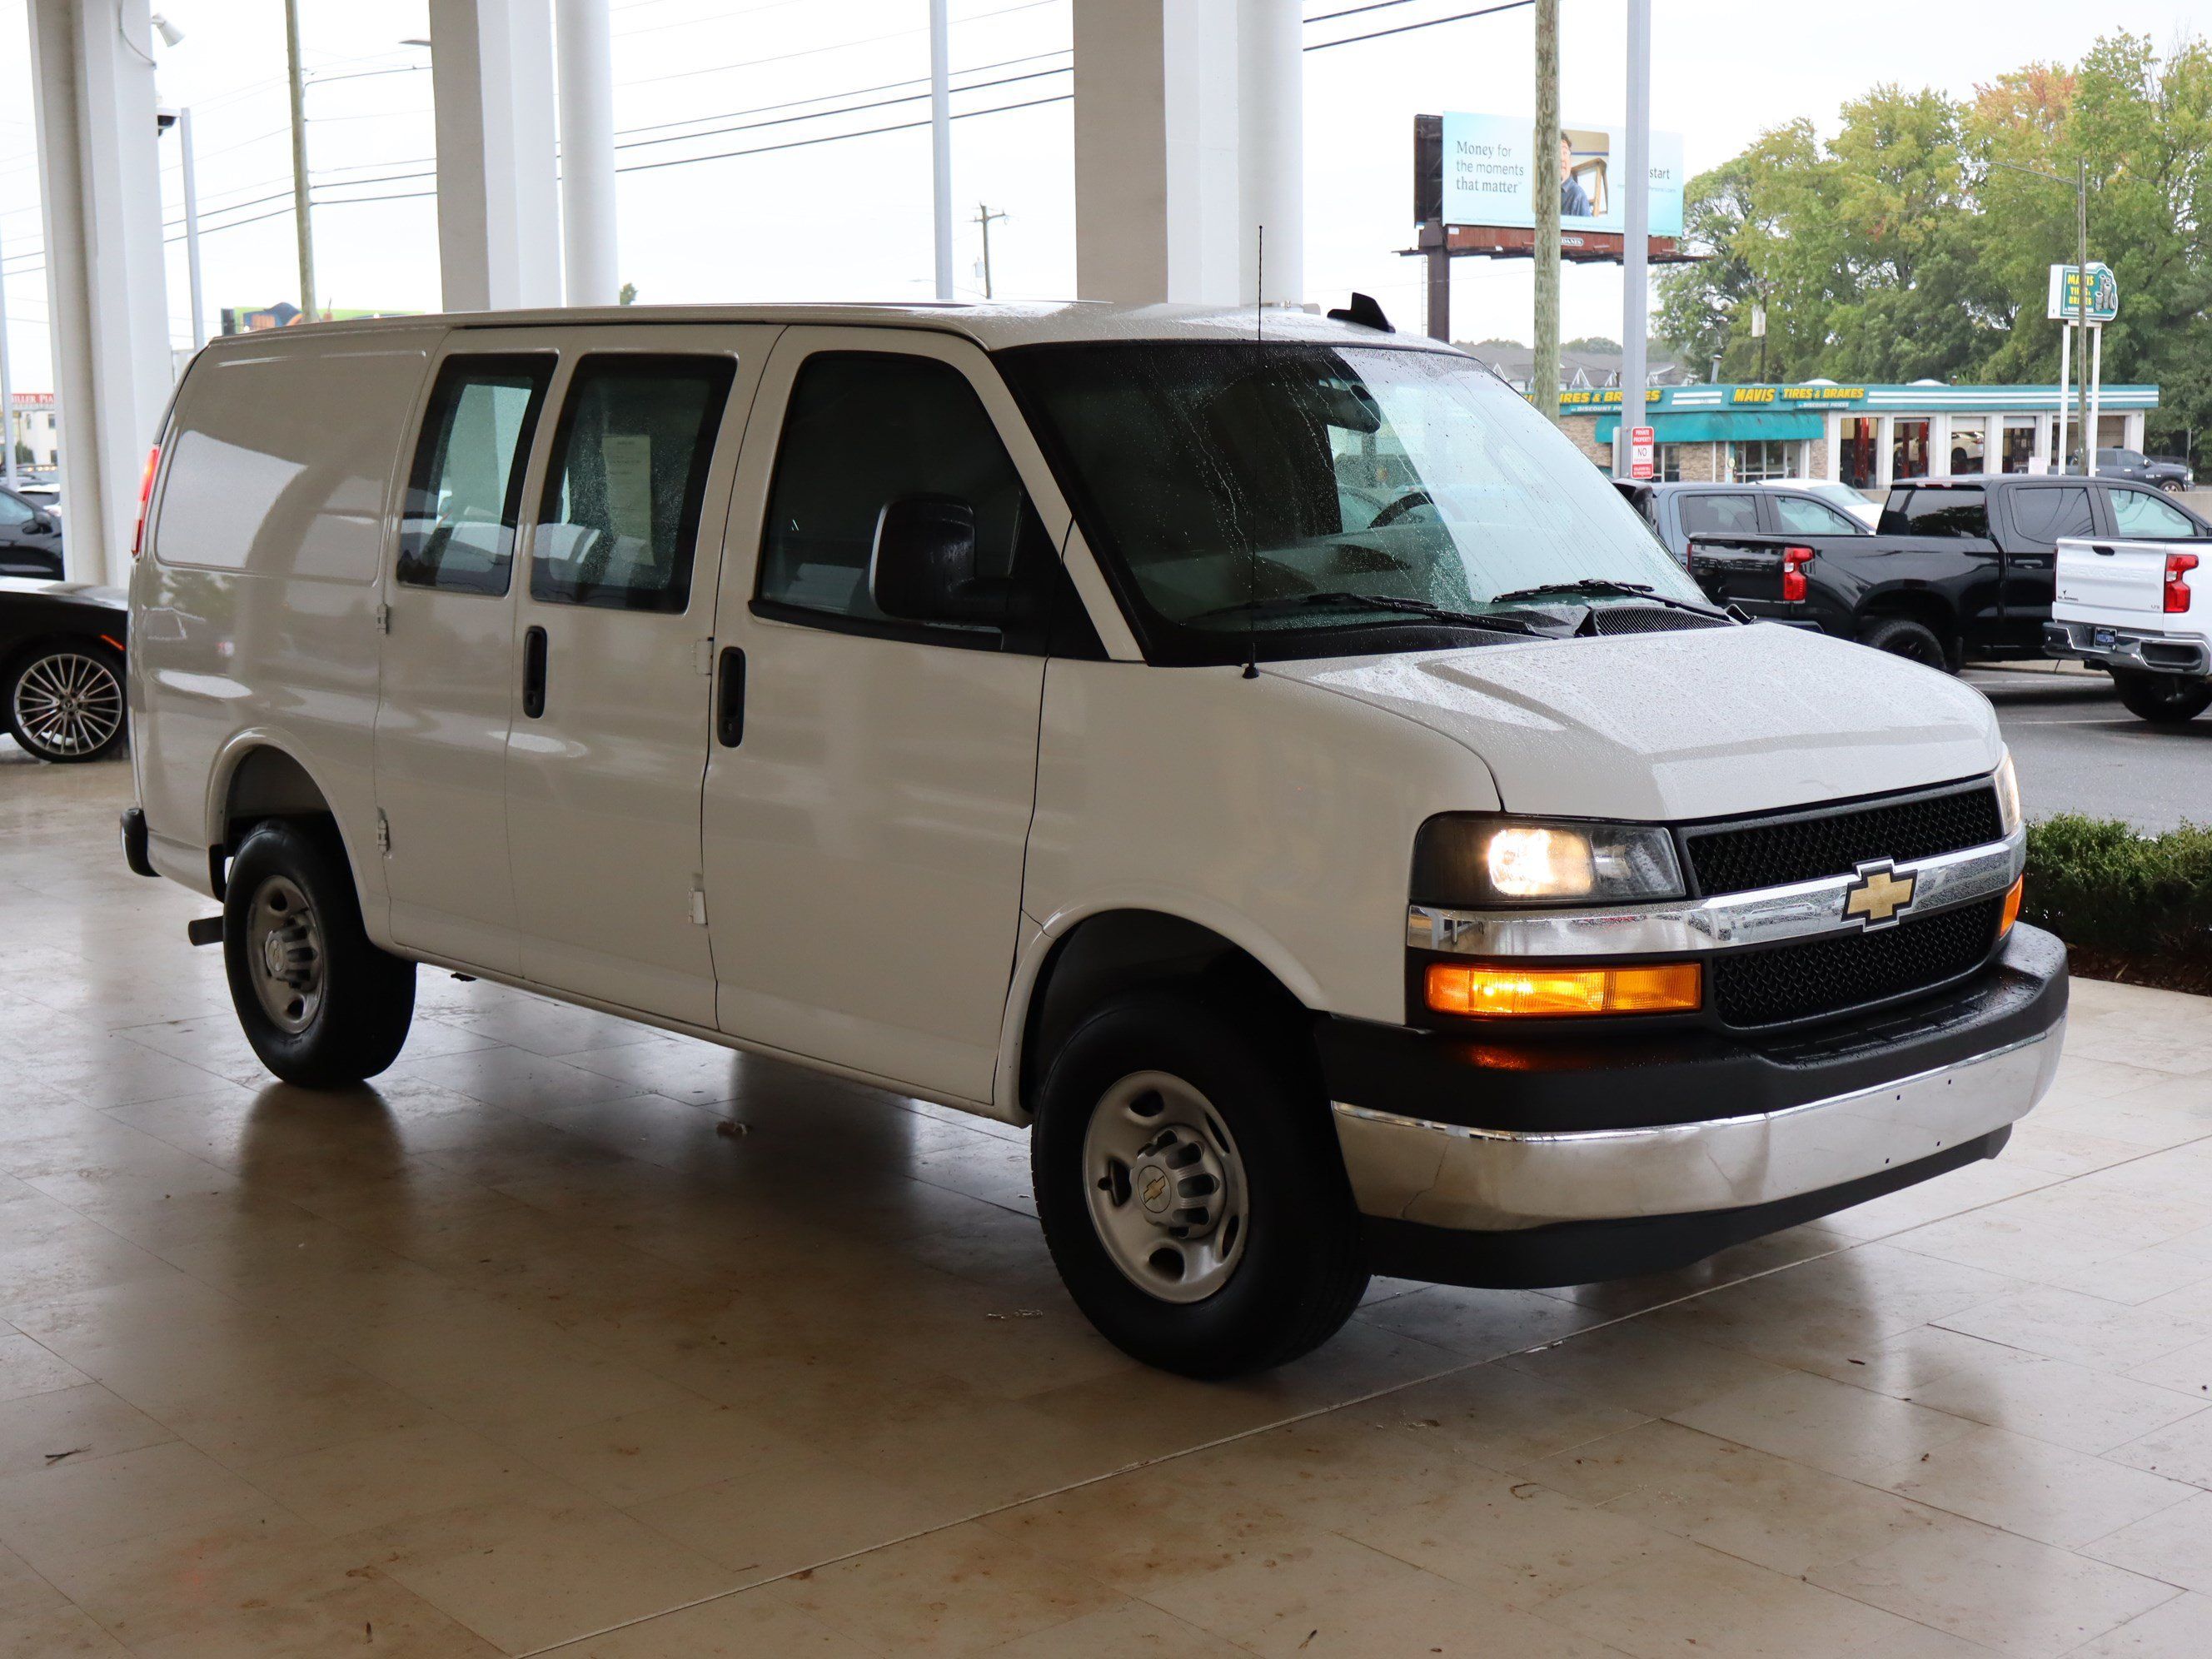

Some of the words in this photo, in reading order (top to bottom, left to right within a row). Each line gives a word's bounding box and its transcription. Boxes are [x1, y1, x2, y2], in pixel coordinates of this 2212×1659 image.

[1457, 141, 1493, 159] Money
[1497, 144, 1512, 157] for
[1456, 160, 1473, 172] the
[1477, 163, 1524, 176] moments
[1456, 177, 1479, 191] that
[1482, 181, 1518, 193] matter
[2068, 274, 2094, 286] MAIS
[2069, 296, 2092, 306] BRES
[1560, 392, 1591, 403] IRES
[1592, 394, 1602, 403] &
[1604, 391, 1661, 402] BRES
[1733, 388, 1776, 402] MAVIS
[1783, 388, 1813, 399] TIRES
[1814, 390, 1821, 399] &
[1822, 388, 1864, 399] BRAKES
[1637, 447, 1647, 457] NO
